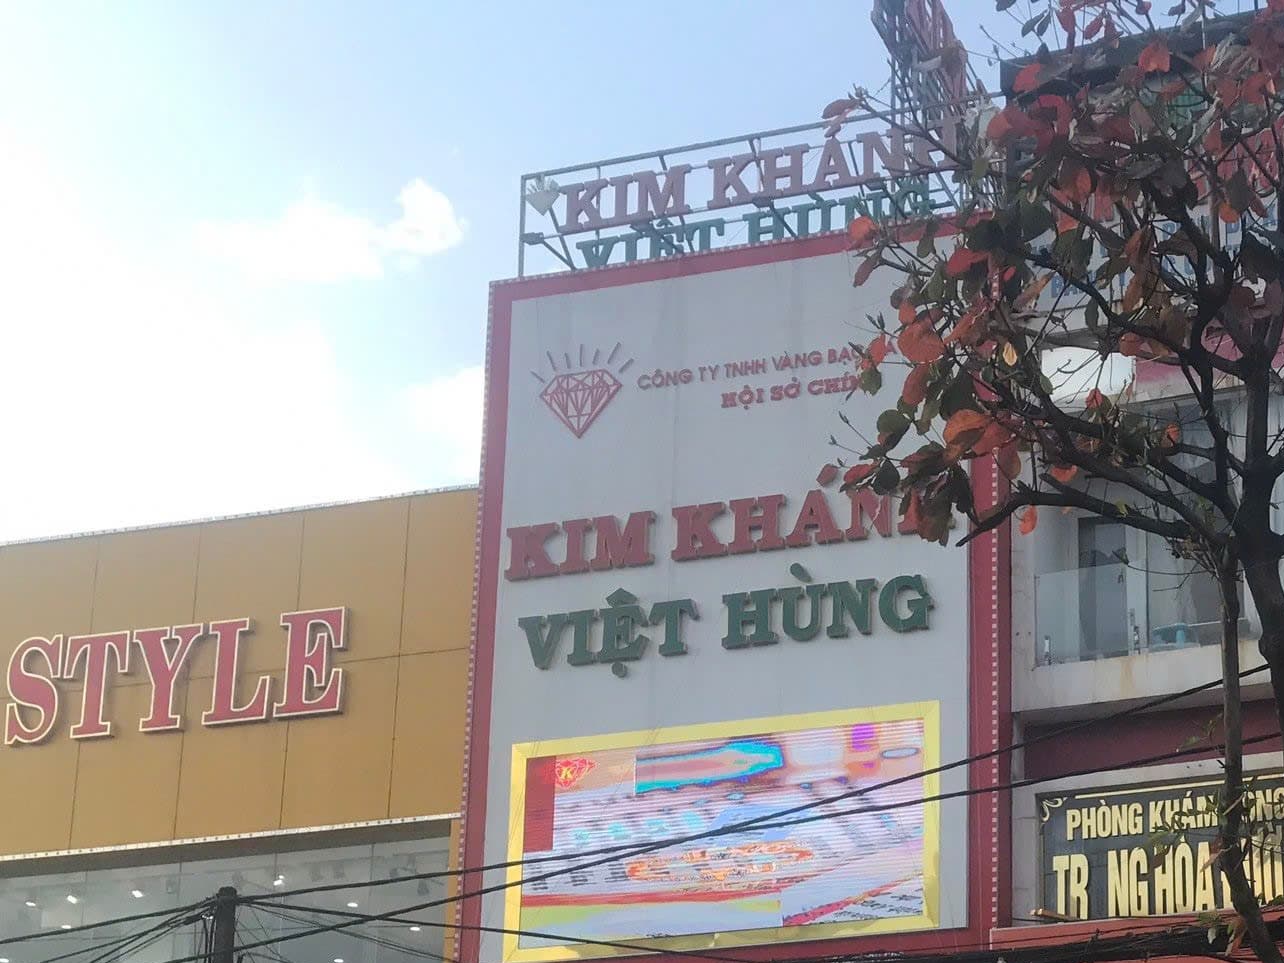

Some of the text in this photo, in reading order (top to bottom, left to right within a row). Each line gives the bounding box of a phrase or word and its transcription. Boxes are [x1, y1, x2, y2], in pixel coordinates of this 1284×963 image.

[556, 163, 692, 233] KIM
[637, 368, 694, 390] CÔNG
[698, 363, 719, 381] TY
[724, 357, 767, 378] TNHH
[772, 350, 822, 371] VÀNG
[808, 371, 861, 395] CHÍ
[504, 463, 956, 582] KIM KHÁN
[518, 562, 935, 679] VIỆT HÙNG
[4, 606, 347, 746] STYLE
[1066, 799, 1143, 841] PHÒNG
